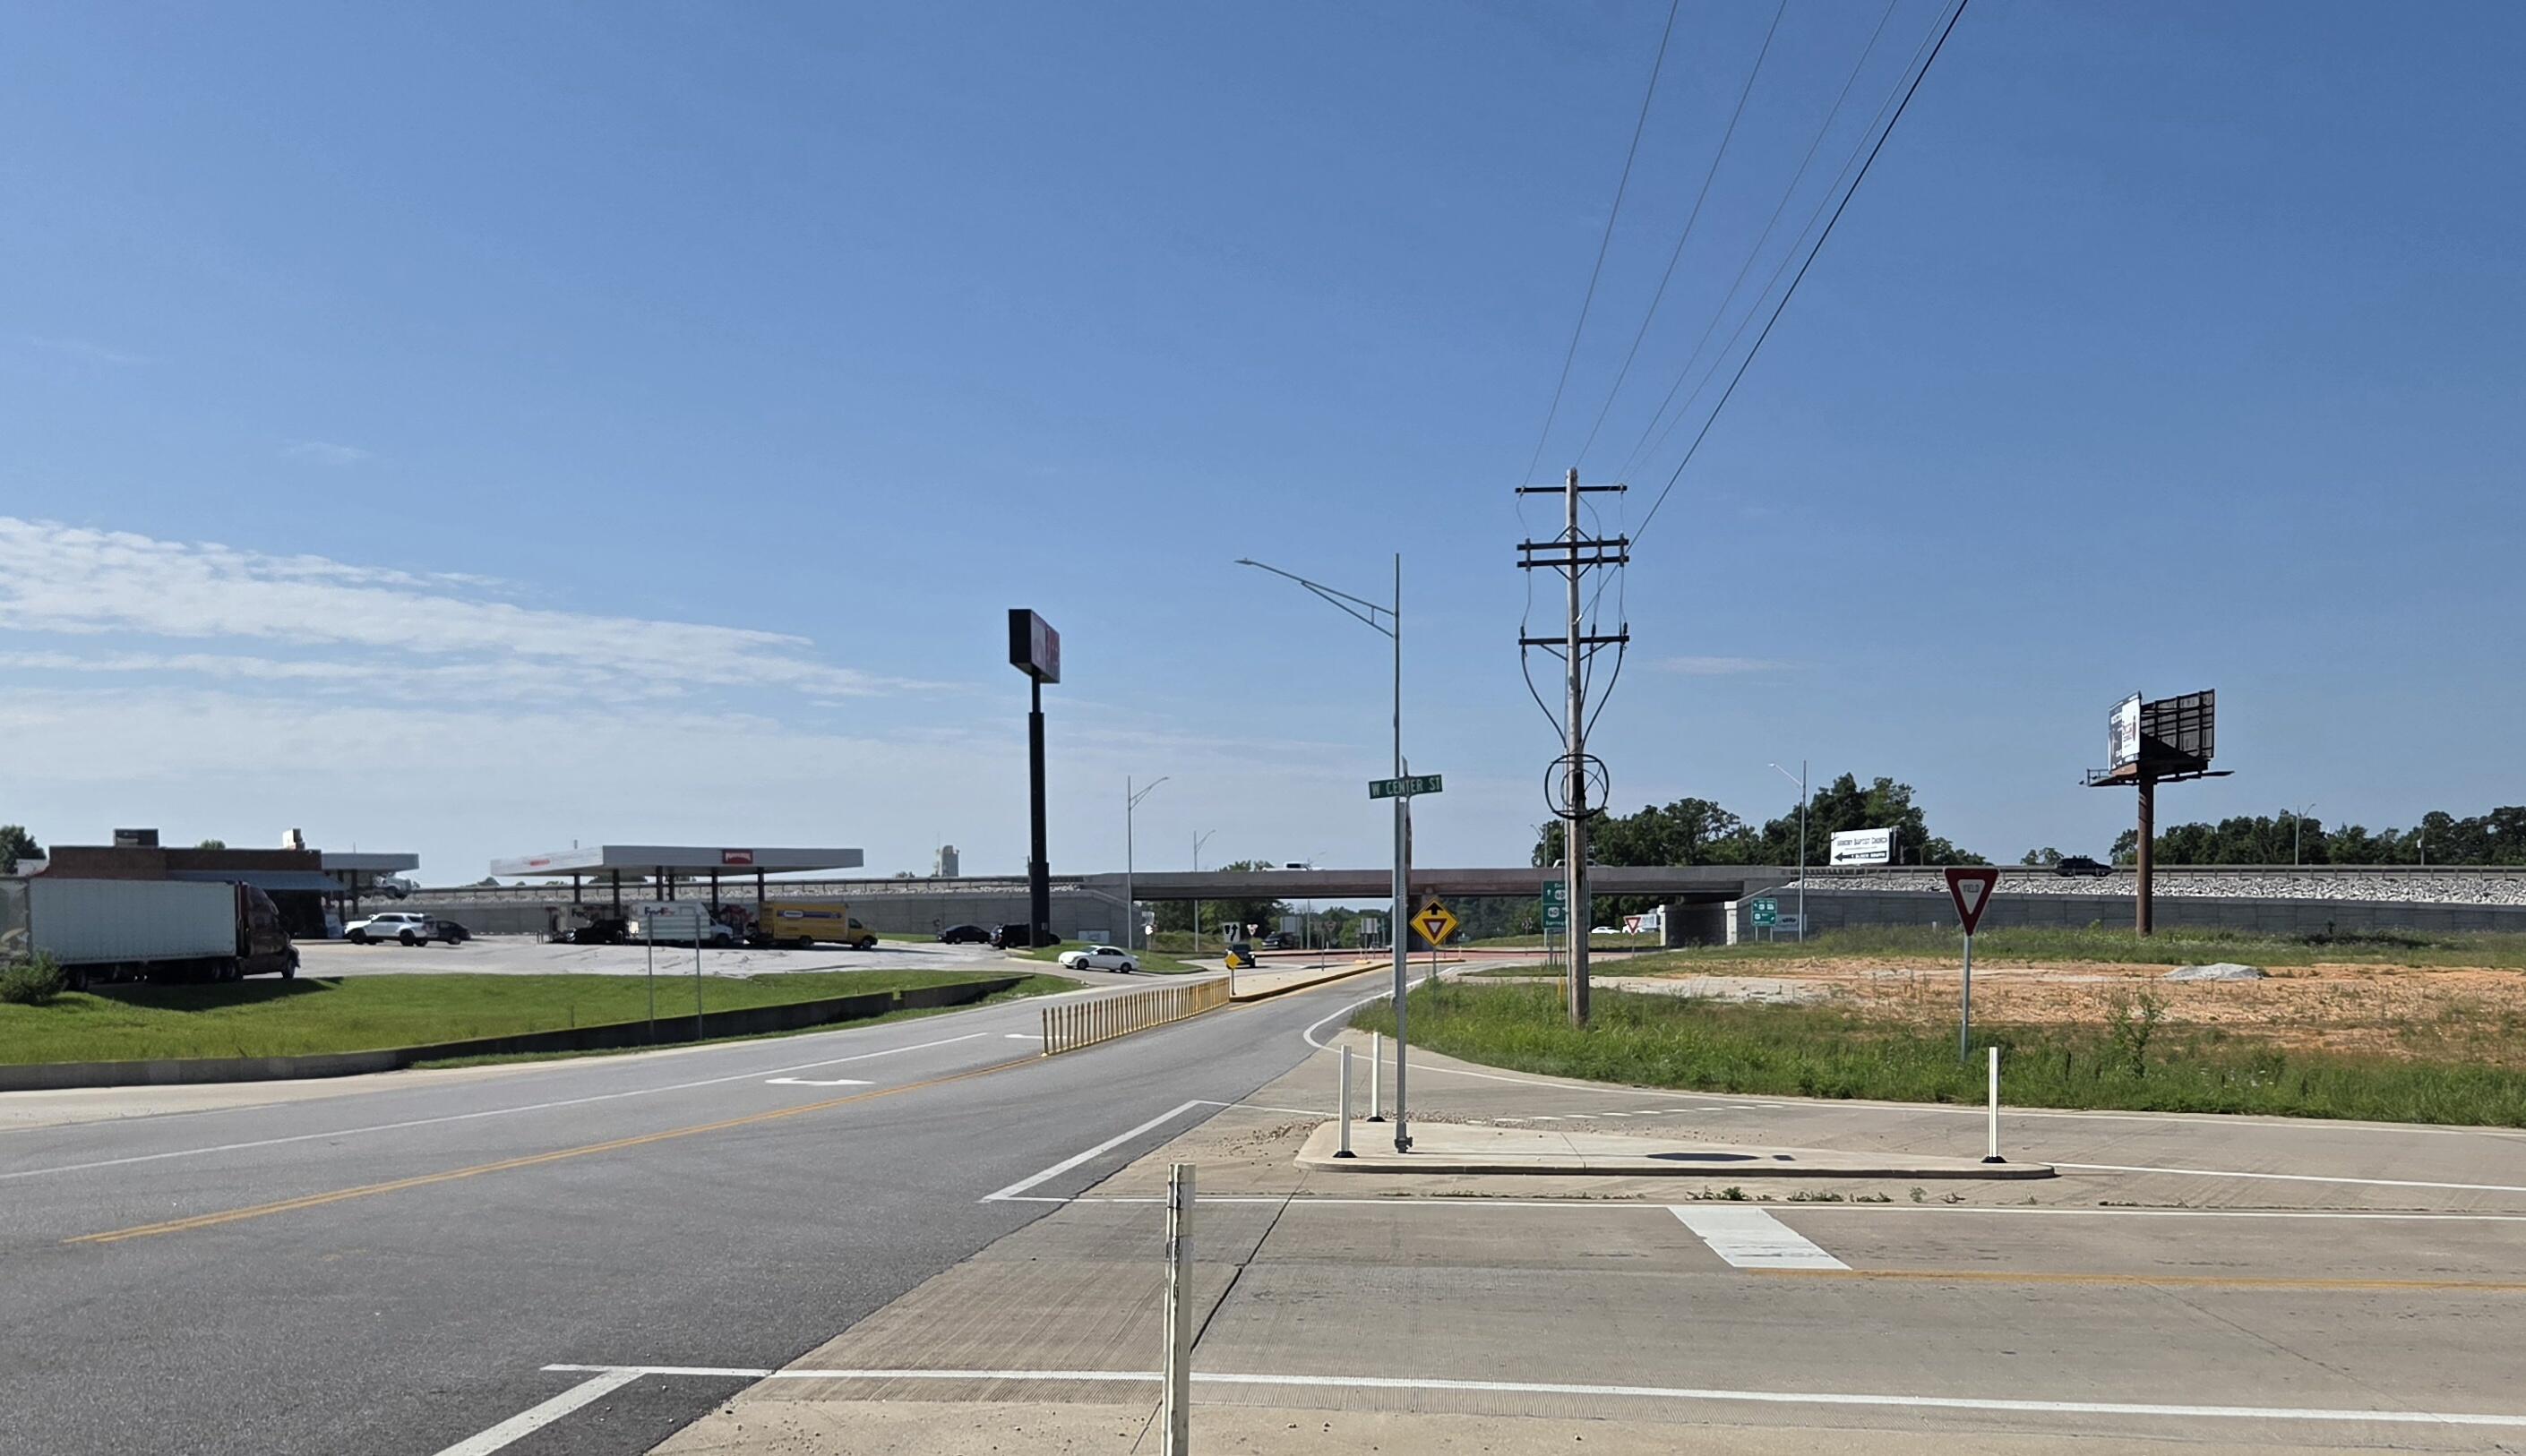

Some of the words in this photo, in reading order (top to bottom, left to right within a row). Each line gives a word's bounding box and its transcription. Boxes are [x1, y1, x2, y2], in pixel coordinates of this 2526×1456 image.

[1371, 783, 1380, 796] W
[1386, 779, 1423, 795] CENTER
[1429, 777, 1440, 791] ST
[1963, 884, 1980, 893] YIELD
